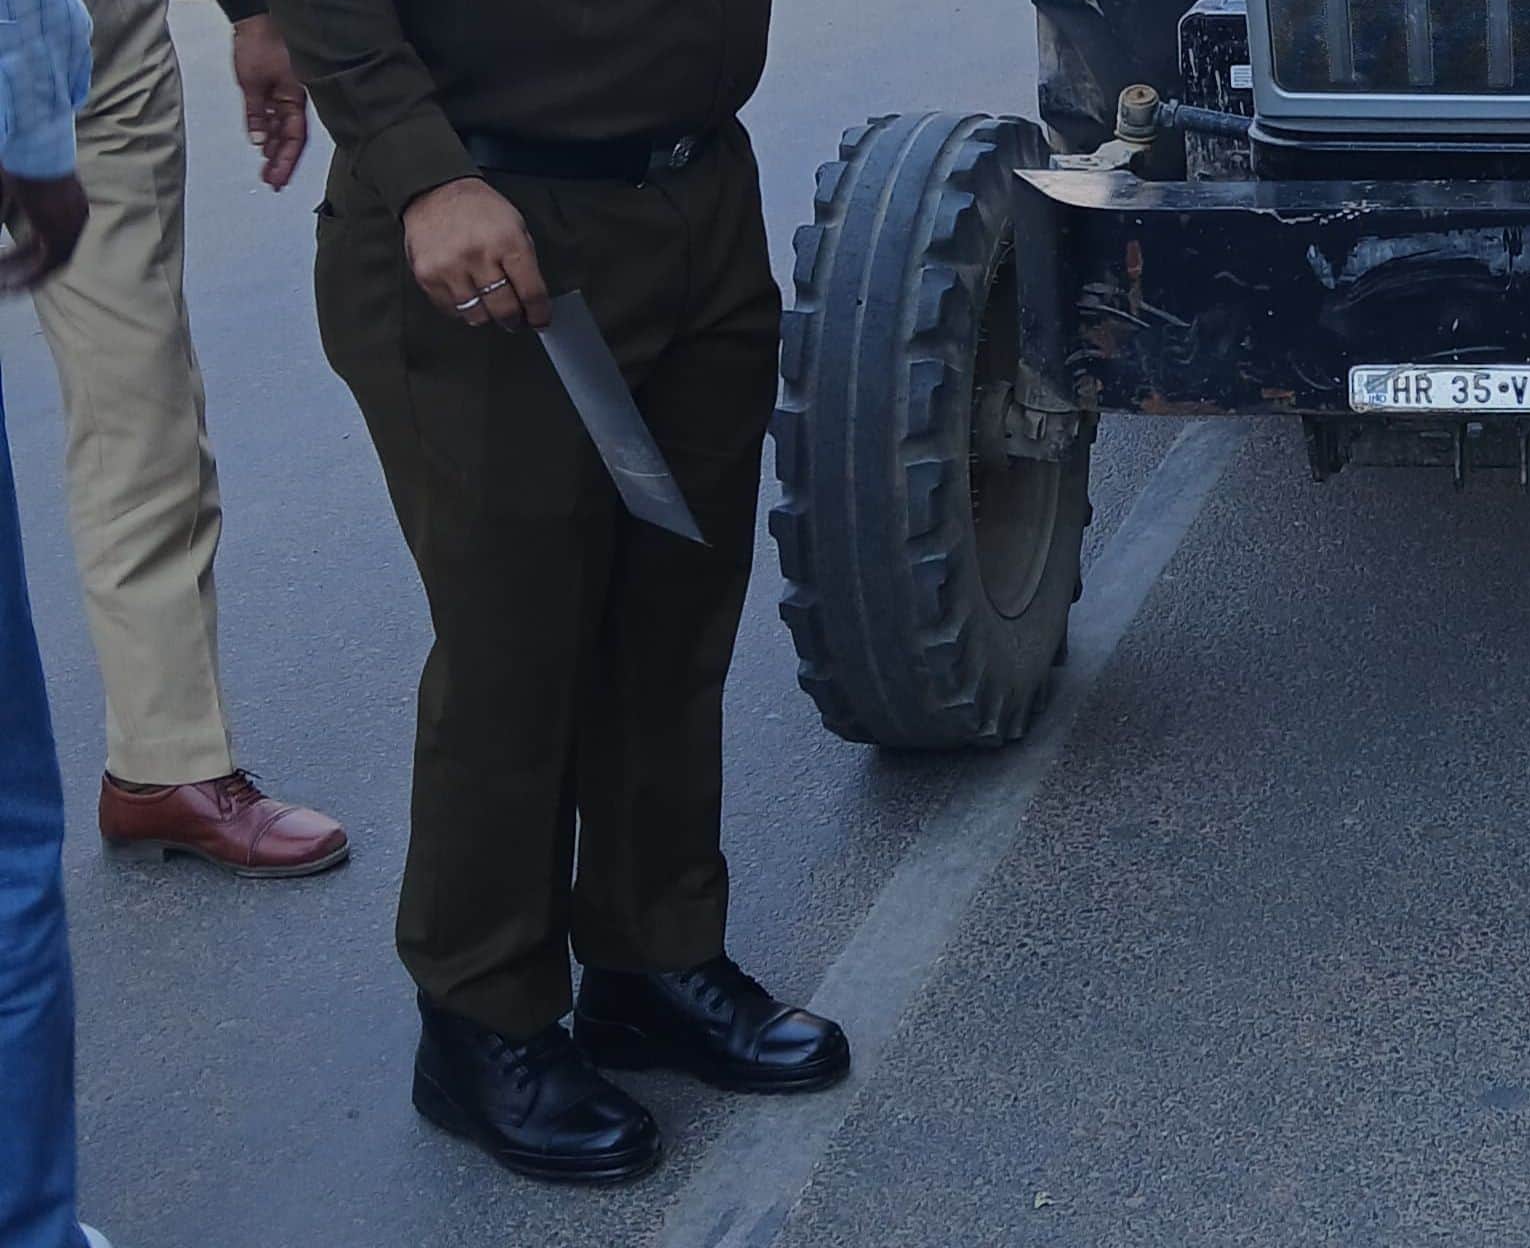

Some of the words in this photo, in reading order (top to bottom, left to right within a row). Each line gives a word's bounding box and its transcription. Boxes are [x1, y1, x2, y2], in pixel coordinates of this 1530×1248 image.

[1392, 373, 1433, 405] HR
[1451, 373, 1492, 404] 35
[1510, 374, 1529, 404] V
